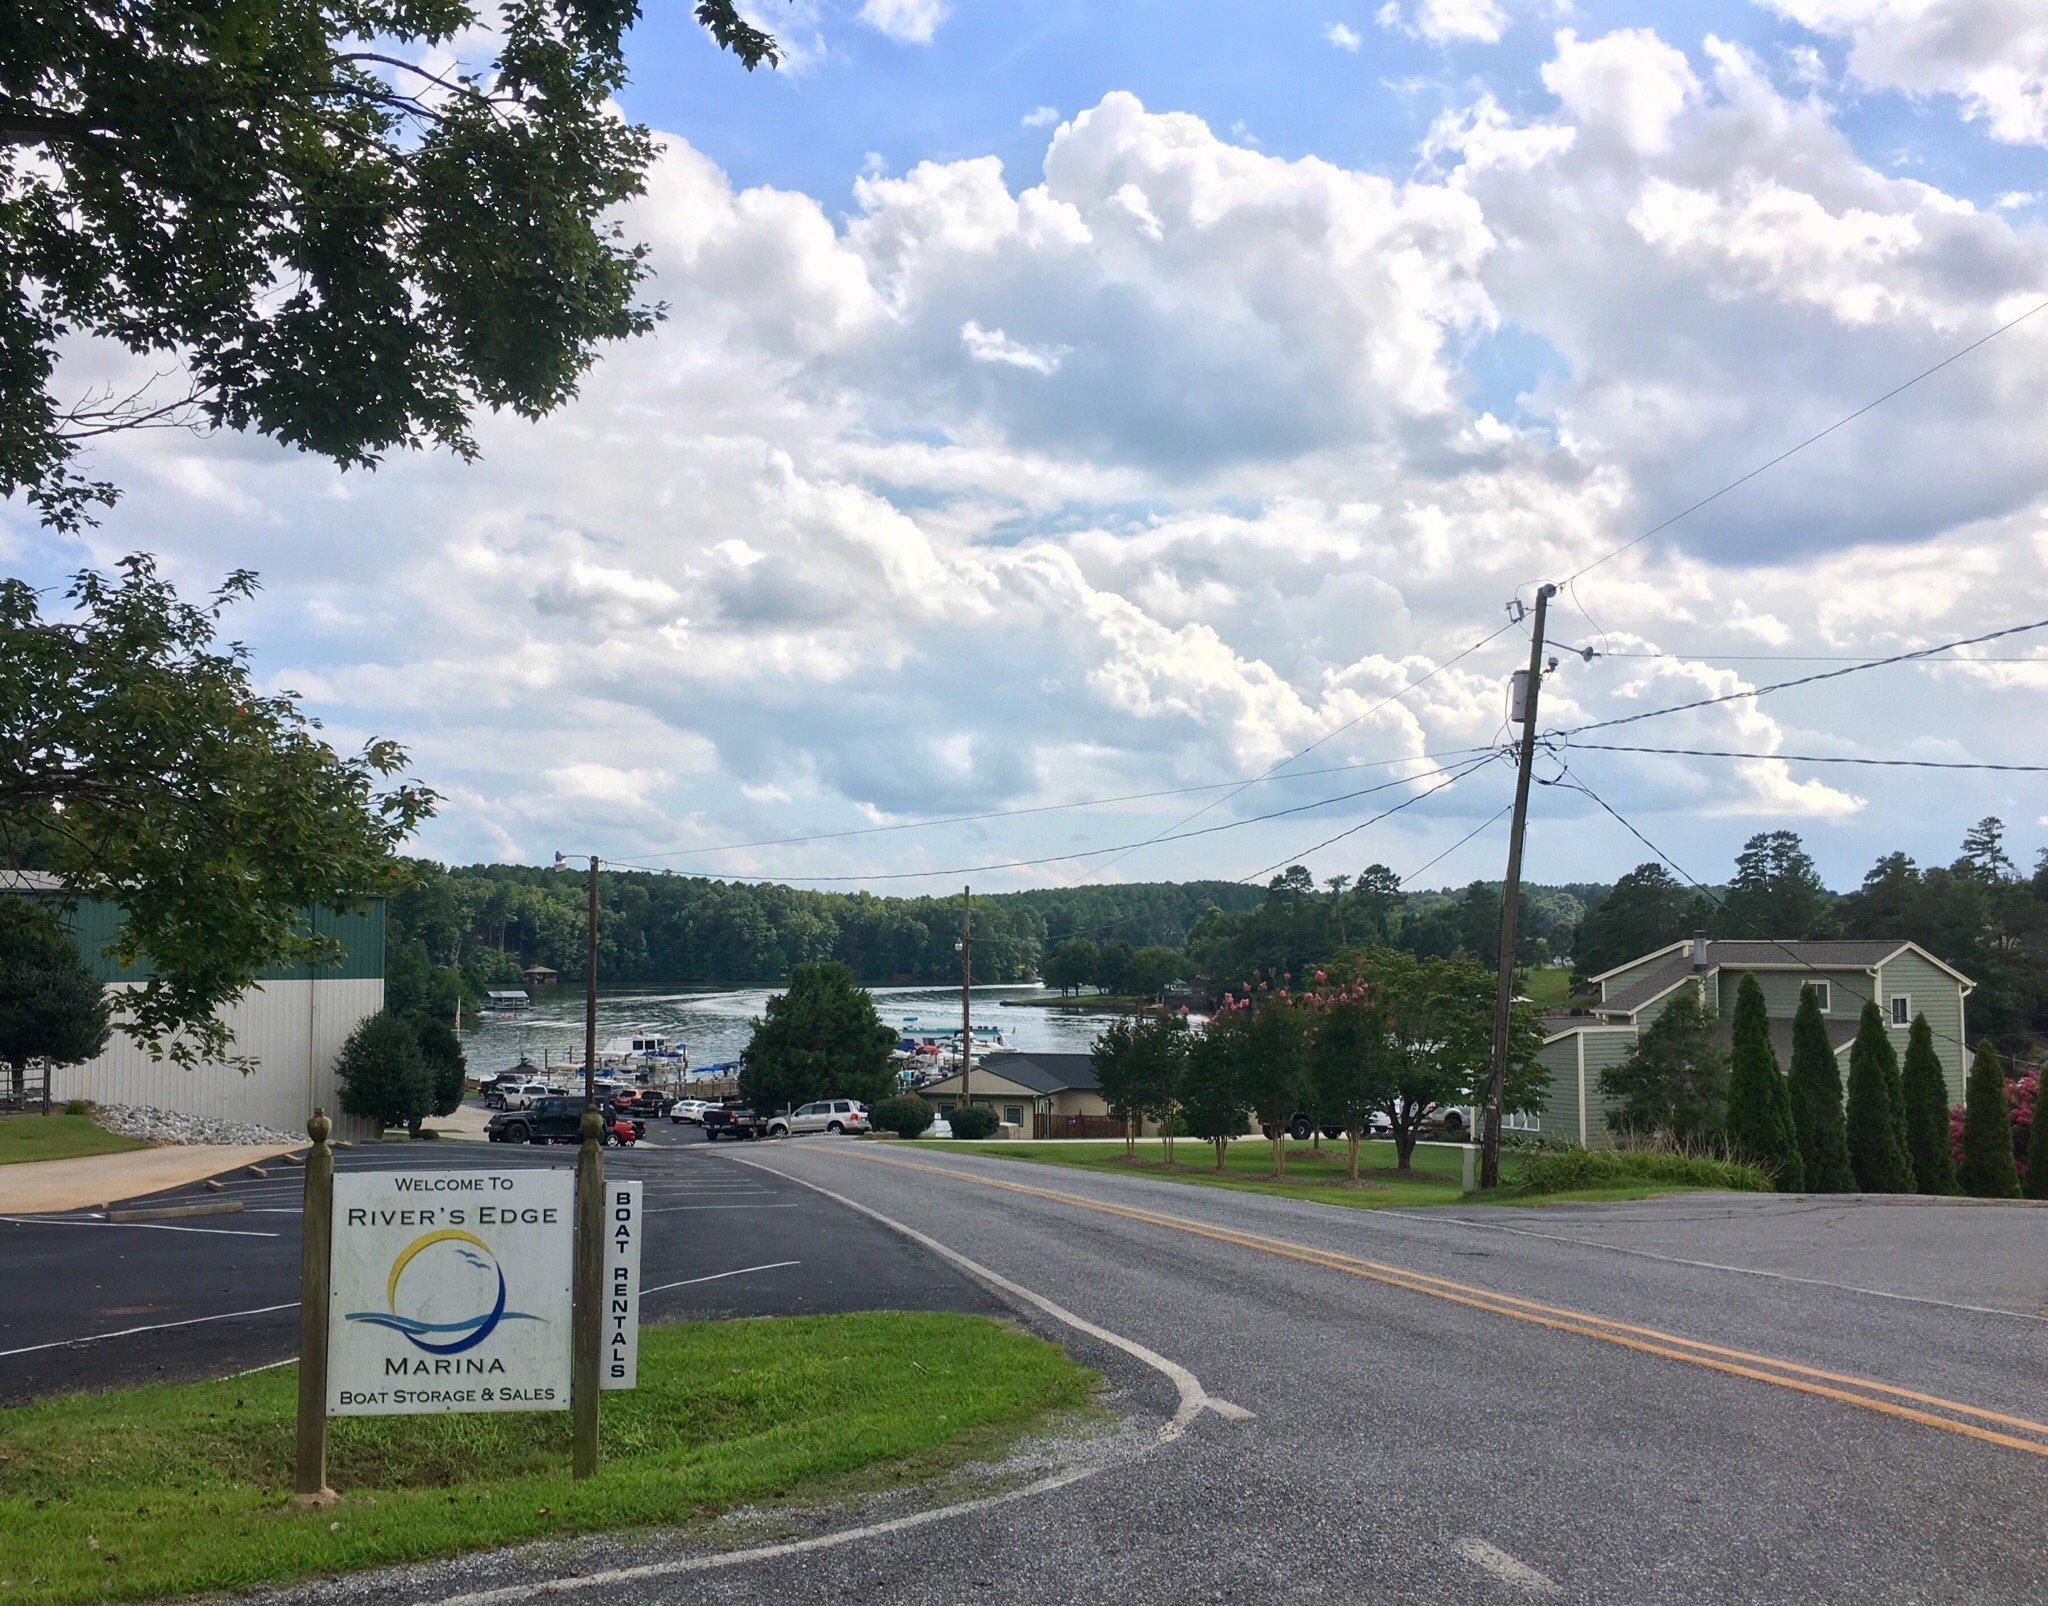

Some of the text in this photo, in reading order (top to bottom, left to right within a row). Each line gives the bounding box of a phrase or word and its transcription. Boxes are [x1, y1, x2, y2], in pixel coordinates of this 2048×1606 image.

[395, 1176, 513, 1192] WELCOME TO
[347, 1206, 557, 1226] RIVER'S EDGE
[610, 1191, 631, 1378] BOAT RENTALS
[384, 1357, 505, 1376] MARINA
[340, 1387, 555, 1405] BOAT STORAGE & SALES
